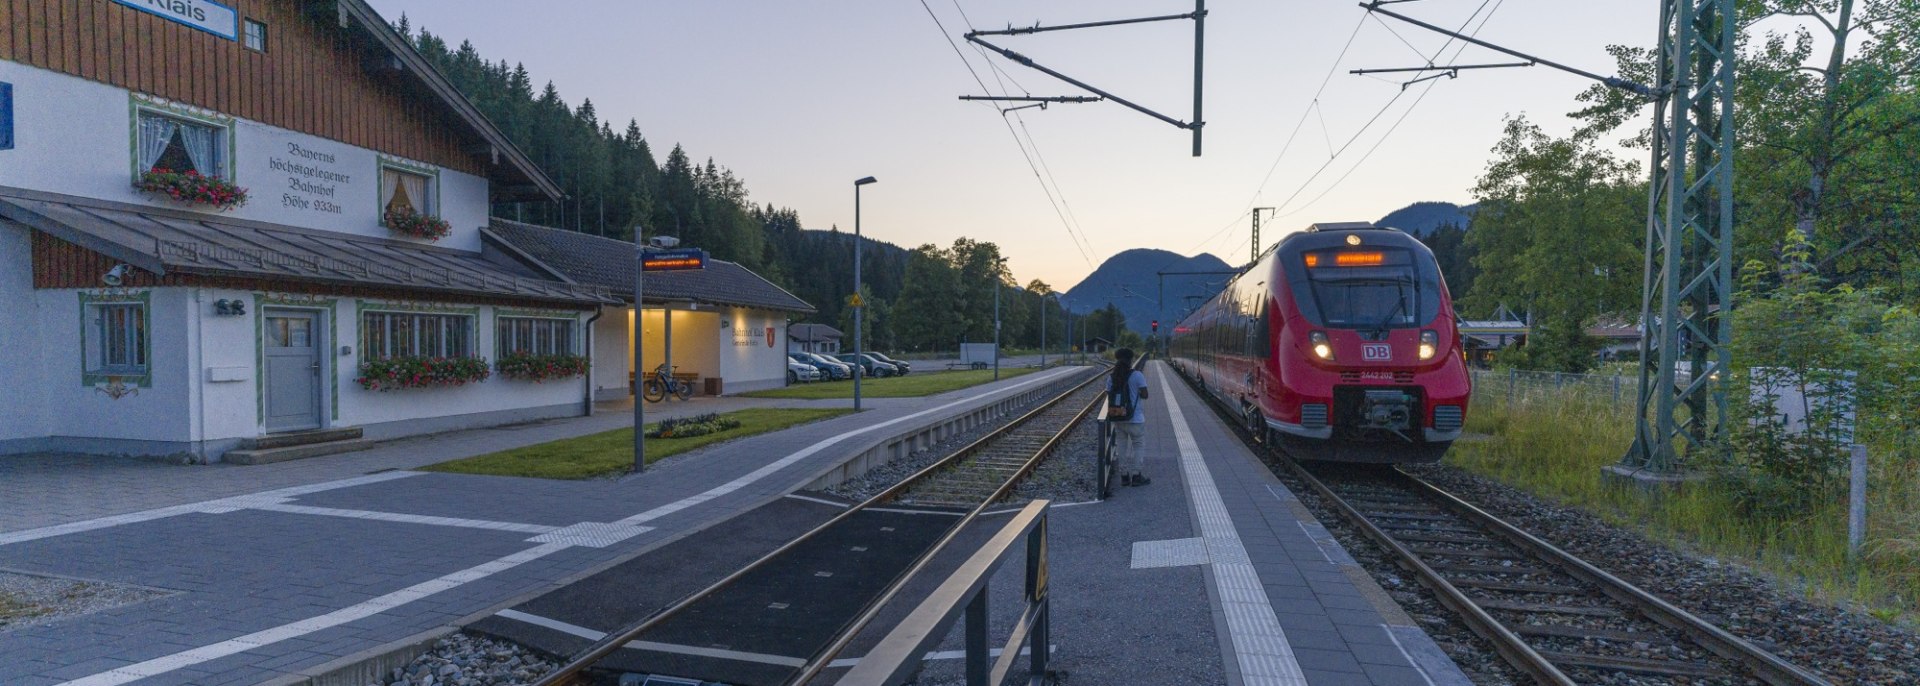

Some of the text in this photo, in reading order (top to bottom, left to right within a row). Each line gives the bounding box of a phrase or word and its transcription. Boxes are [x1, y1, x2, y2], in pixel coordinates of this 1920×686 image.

[287, 142, 335, 164] Bayerns
[269, 156, 351, 184] höchstgelegener
[288, 177, 336, 199] Bahnhof
[281, 193, 342, 214] Höhe 933m
[1364, 346, 1389, 358] DB
[1361, 371, 1379, 379] 2442
